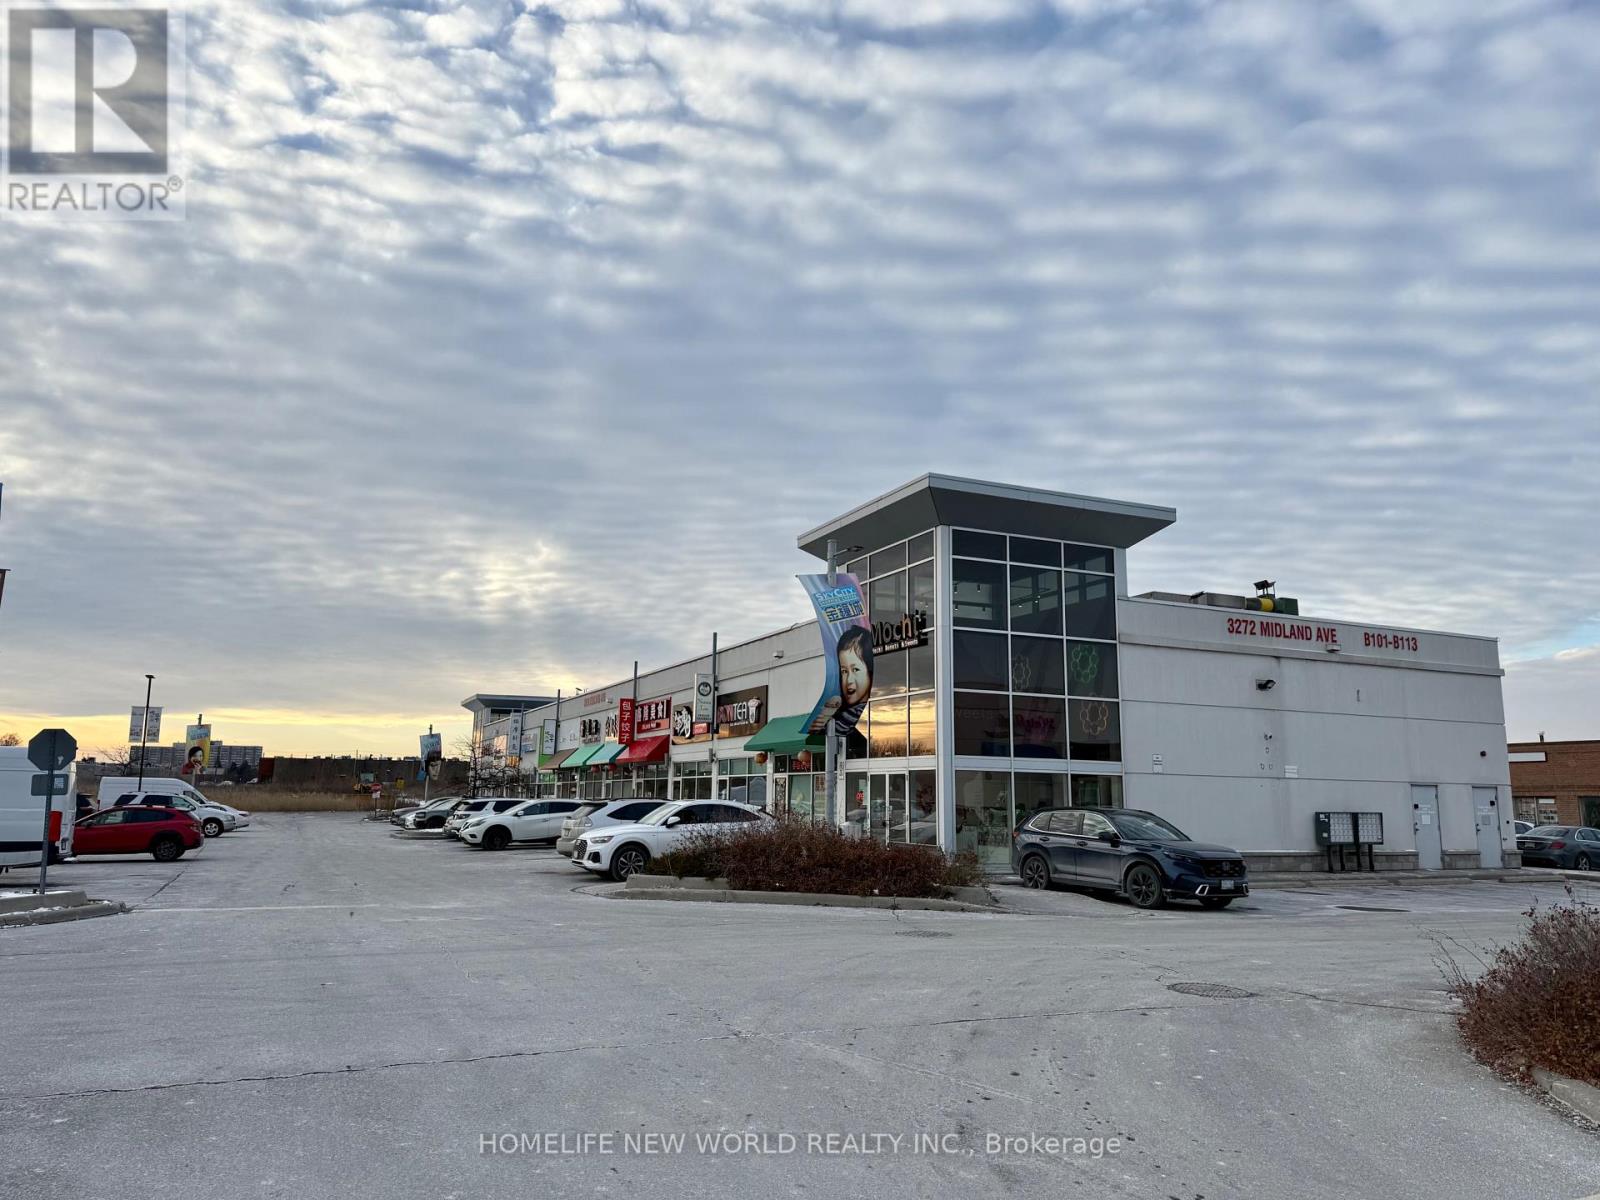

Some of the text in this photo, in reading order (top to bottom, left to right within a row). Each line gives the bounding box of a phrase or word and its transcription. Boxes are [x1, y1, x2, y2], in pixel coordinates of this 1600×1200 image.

[1227, 617, 1417, 652] 3272 MIDLAND AVE B101-B113
